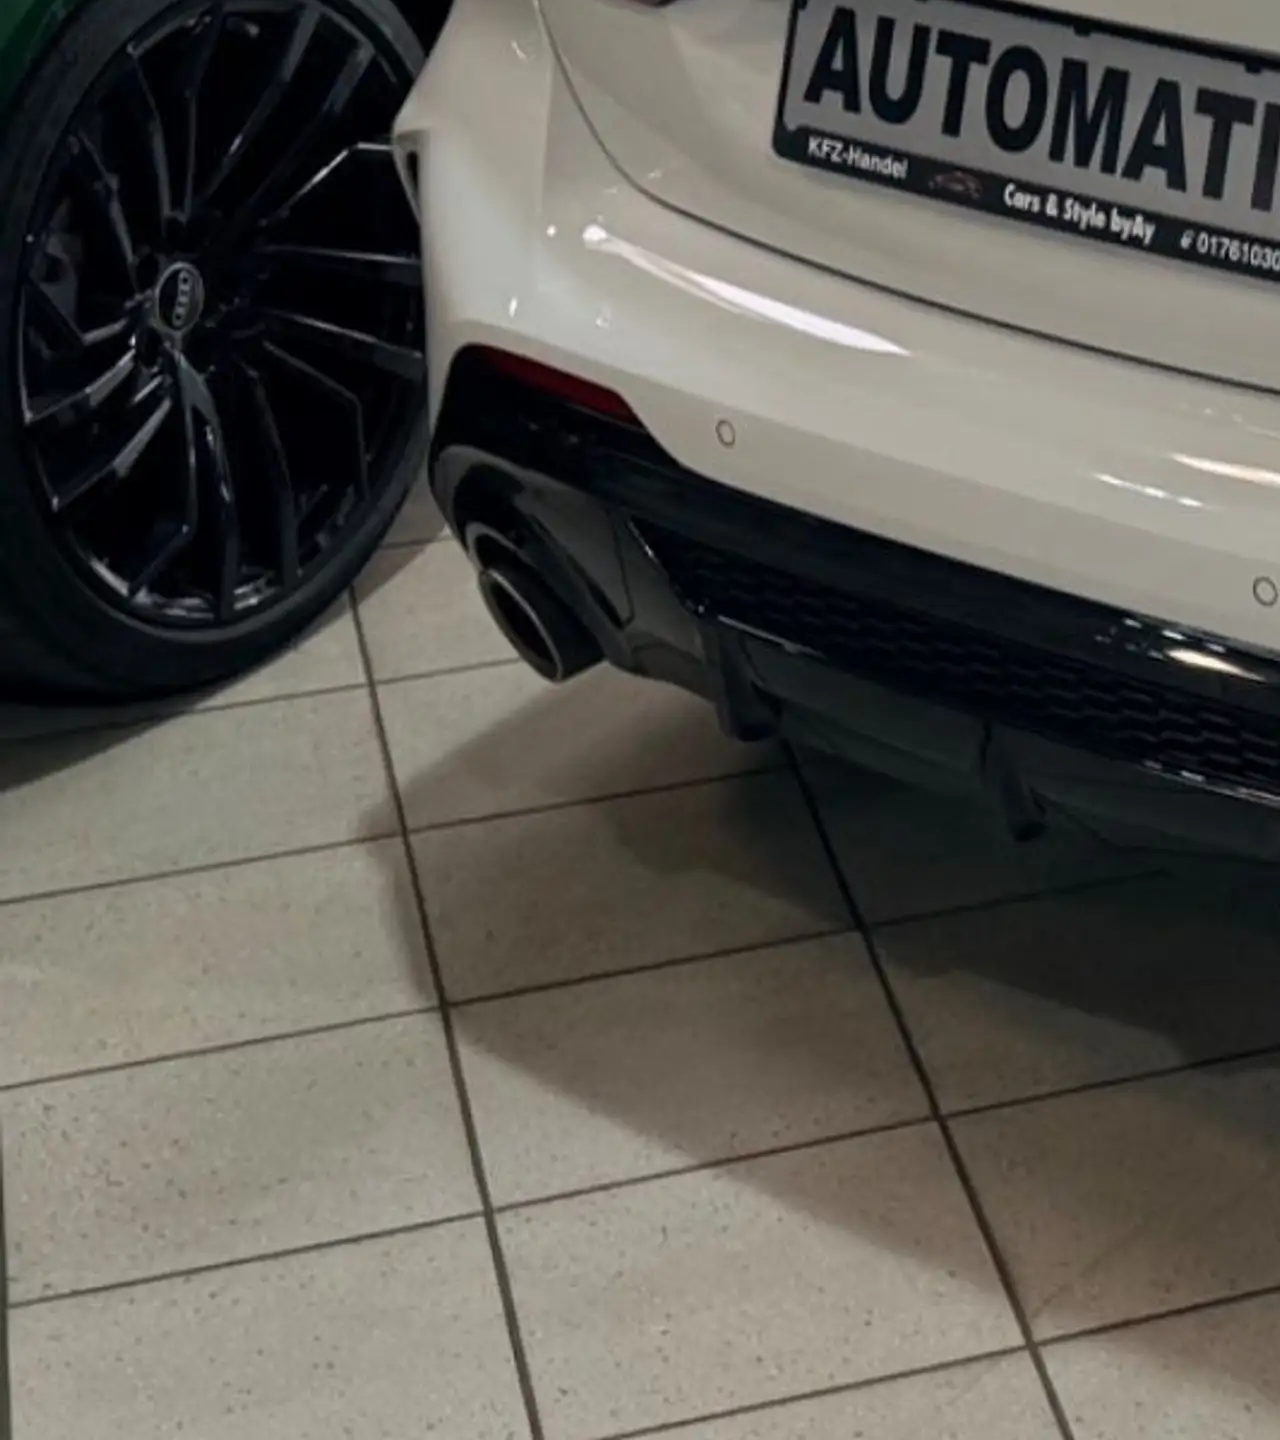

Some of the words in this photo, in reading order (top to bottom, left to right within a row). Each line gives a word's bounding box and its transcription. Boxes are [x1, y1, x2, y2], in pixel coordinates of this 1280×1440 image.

[807, 135, 909, 179] KFZ-Handel
[1003, 182, 1041, 213] Cars
[1045, 194, 1059, 219] &
[1063, 198, 1107, 231] Style
